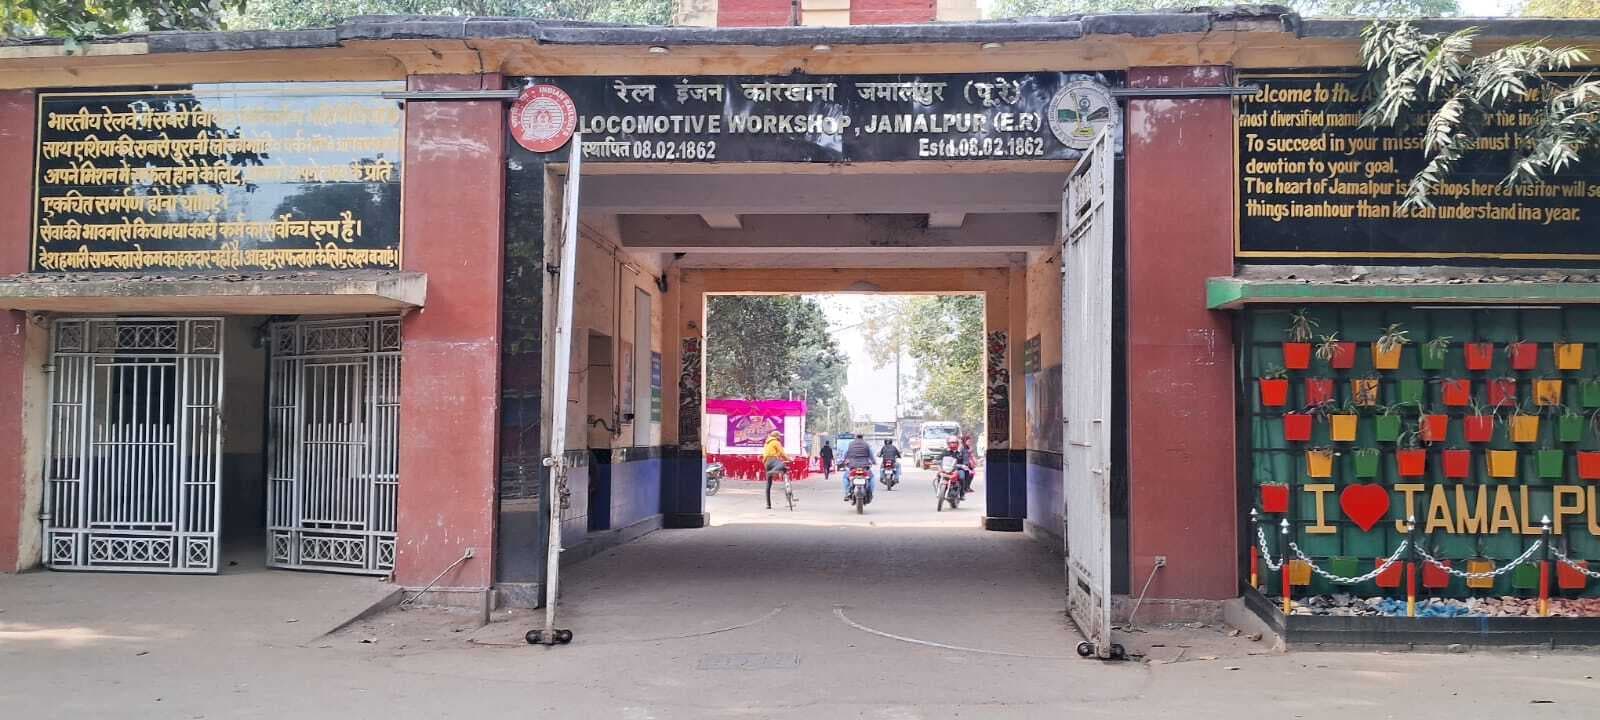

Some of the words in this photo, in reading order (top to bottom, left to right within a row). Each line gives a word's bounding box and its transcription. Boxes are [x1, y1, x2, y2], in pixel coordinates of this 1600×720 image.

[613, 79, 656, 103] रेल
[674, 78, 724, 104] इंजन
[855, 80, 947, 106] जमालपुर
[1313, 82, 1329, 102] to
[48, 106, 100, 131] भारतीय
[101, 105, 136, 132] रेलवे
[580, 113, 720, 135] LOCOMOTIVE
[865, 112, 988, 134] JAMALPUR
[1239, 109, 1268, 128] most
[1270, 109, 1325, 128] diversified
[42, 141, 72, 159] साथ
[581, 135, 632, 159] स्थापित
[633, 140, 716, 159] 08.02.1862
[1245, 133, 1264, 153] To
[1266, 131, 1328, 152] succeed
[1329, 132, 1345, 152] in
[1344, 136, 1378, 156] your
[44, 161, 80, 185] अपने
[364, 158, 394, 185] प्रति
[1245, 157, 1306, 174] devotion
[1308, 157, 1325, 174] to
[1327, 160, 1361, 179] your
[1364, 156, 1399, 178] goal.
[1243, 176, 1274, 195] The
[1274, 176, 1312, 195] heart
[1313, 177, 1329, 195] of
[1328, 177, 1394, 199] Jamalpur
[1432, 179, 1470, 200] shops
[1471, 178, 1501, 197] here
[1514, 180, 1560, 197] visitor
[1561, 180, 1586, 197] will
[94, 187, 145, 215] समर्पण
[147, 187, 177, 216] होना
[1246, 199, 1289, 221] things
[1356, 199, 1391, 218] than
[1392, 200, 1409, 219] he
[1410, 205, 1436, 218] can
[1438, 201, 1516, 220] understand
[1542, 206, 1580, 226] year.
[1303, 483, 1337, 534] I
